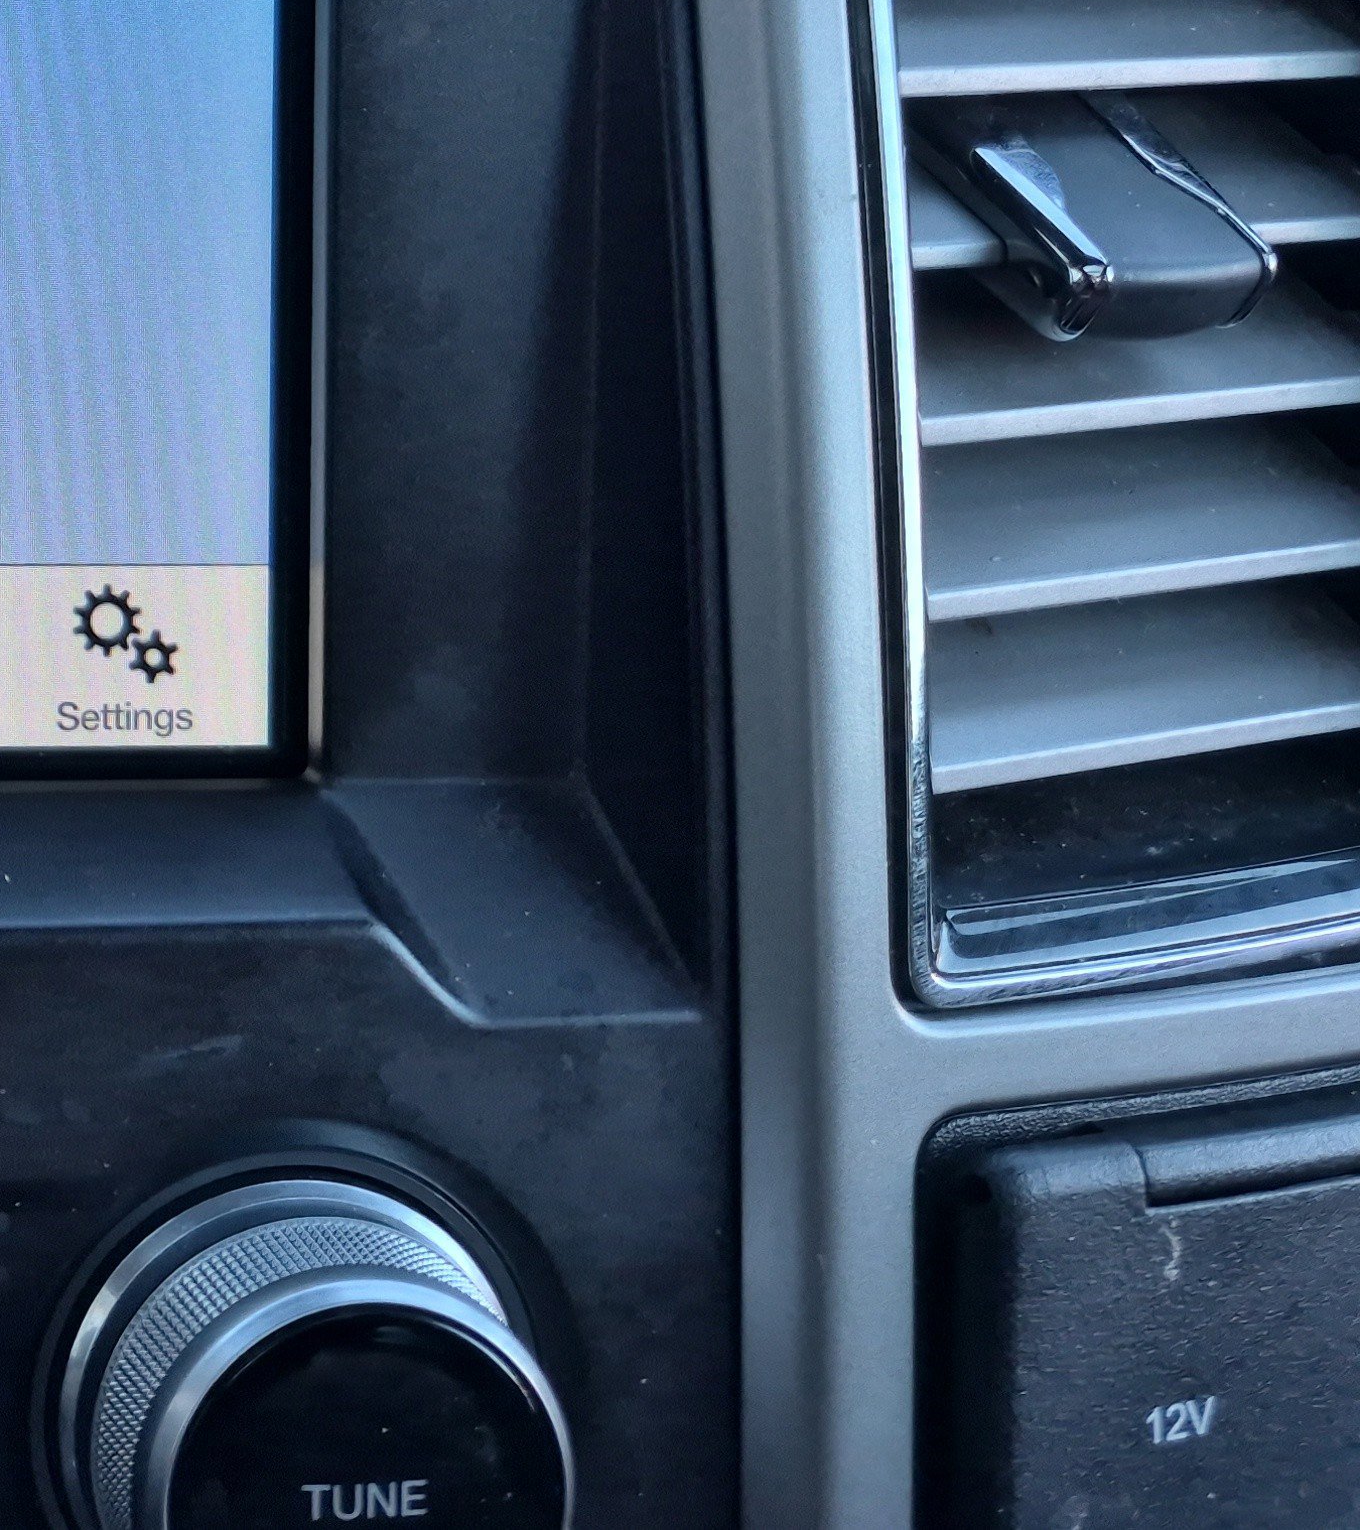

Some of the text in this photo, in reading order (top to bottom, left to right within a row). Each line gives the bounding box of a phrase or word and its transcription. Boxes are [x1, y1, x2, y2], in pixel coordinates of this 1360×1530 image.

[56, 700, 194, 735] Settings
[1145, 1396, 1216, 1444] 12V
[301, 1479, 429, 1521] TUNE
